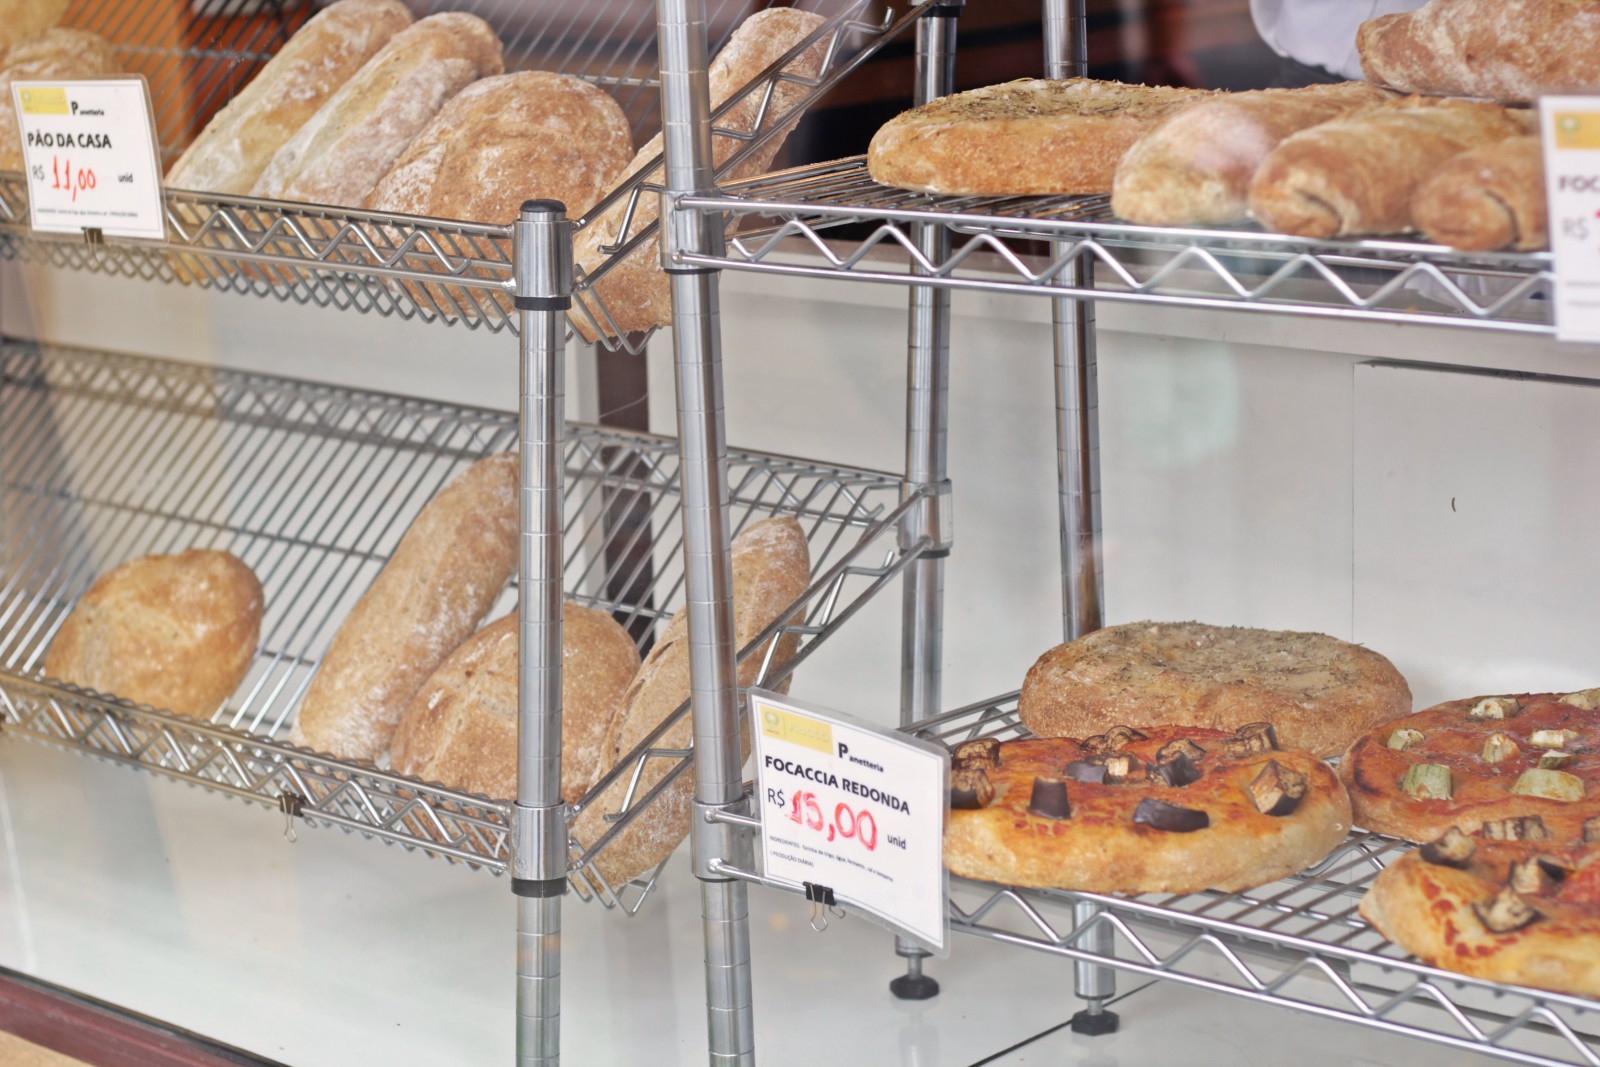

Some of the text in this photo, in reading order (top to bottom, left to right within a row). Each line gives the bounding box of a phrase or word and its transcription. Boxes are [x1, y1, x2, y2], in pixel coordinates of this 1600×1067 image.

[27, 129, 112, 149] PÃO DA CASA
[32, 154, 134, 202] R$ 11,00 unid
[765, 755, 910, 815] FOCACCIA REDONDA
[767, 787, 907, 852] R$ 15,00 unid
